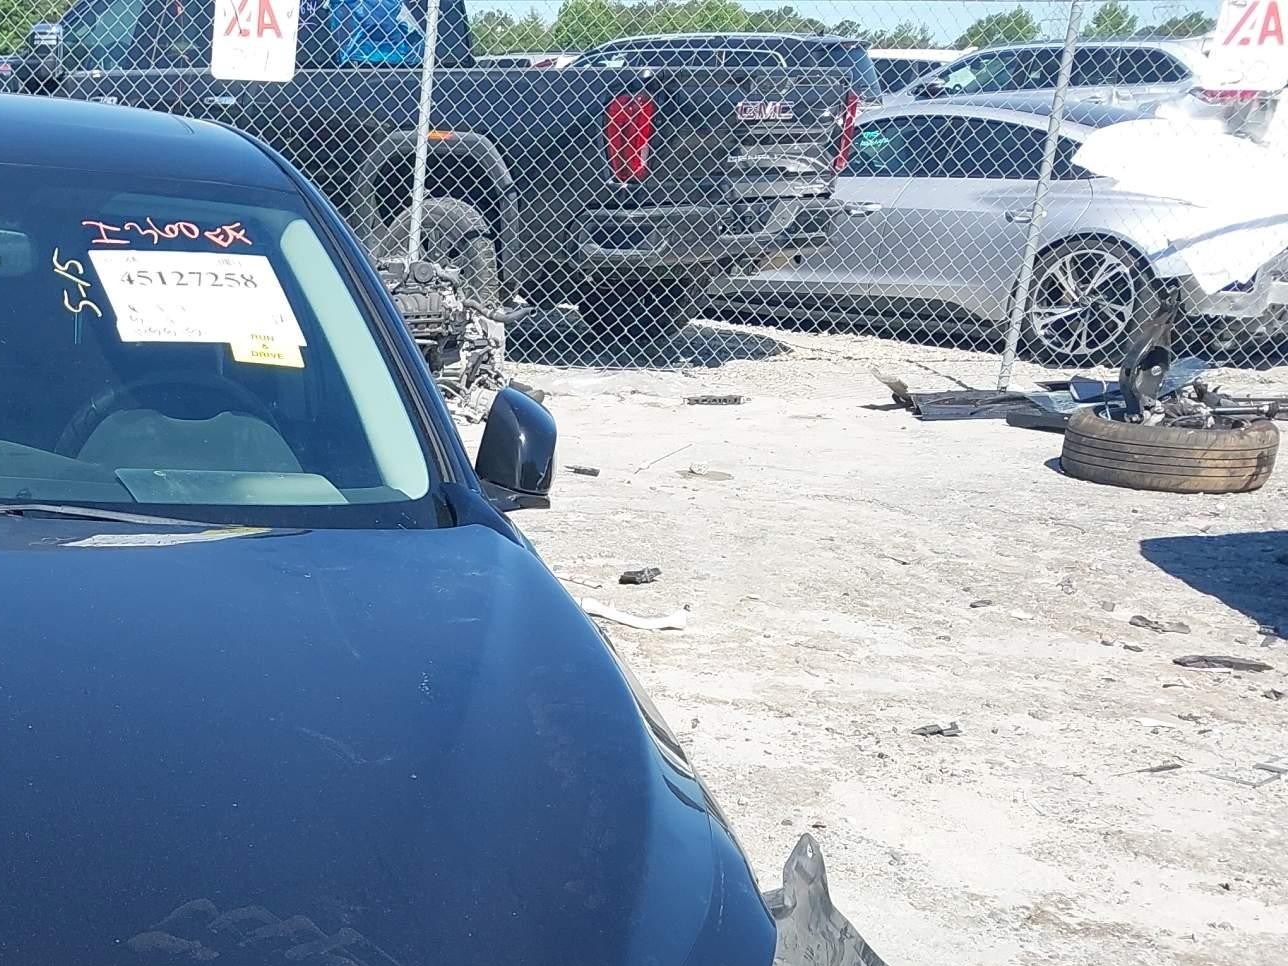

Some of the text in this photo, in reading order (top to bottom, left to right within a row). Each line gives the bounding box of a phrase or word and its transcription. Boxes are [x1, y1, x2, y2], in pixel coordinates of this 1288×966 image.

[737, 100, 794, 120] GMC
[120, 269, 259, 290] 45127258
[250, 333, 276, 342] RUN
[250, 350, 285, 360] DRIVE
